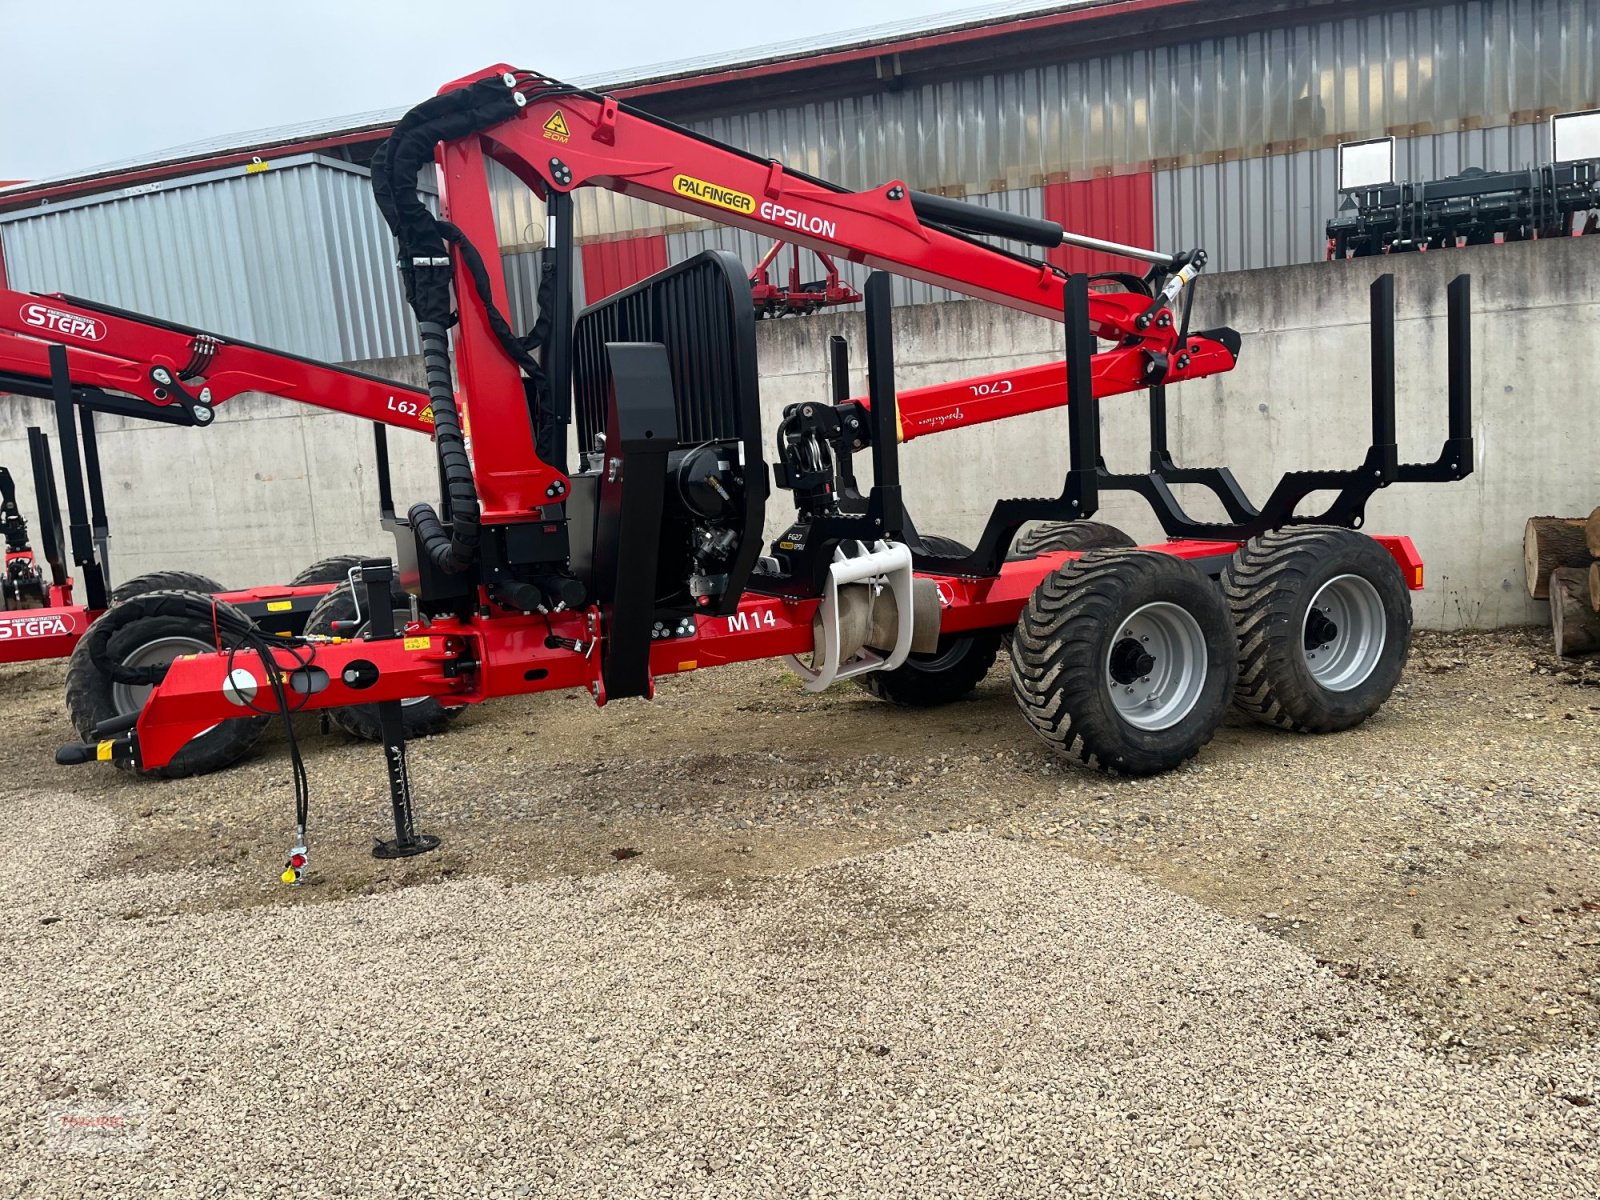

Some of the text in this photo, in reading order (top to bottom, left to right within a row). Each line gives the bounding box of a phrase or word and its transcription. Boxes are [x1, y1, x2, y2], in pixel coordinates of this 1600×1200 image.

[678, 177, 751, 211] PALFINGER
[760, 201, 836, 239] EPSILON
[27, 305, 97, 340] STEPA
[969, 380, 1013, 396] C70L
[387, 396, 417, 416] L62
[727, 609, 776, 633] M14
